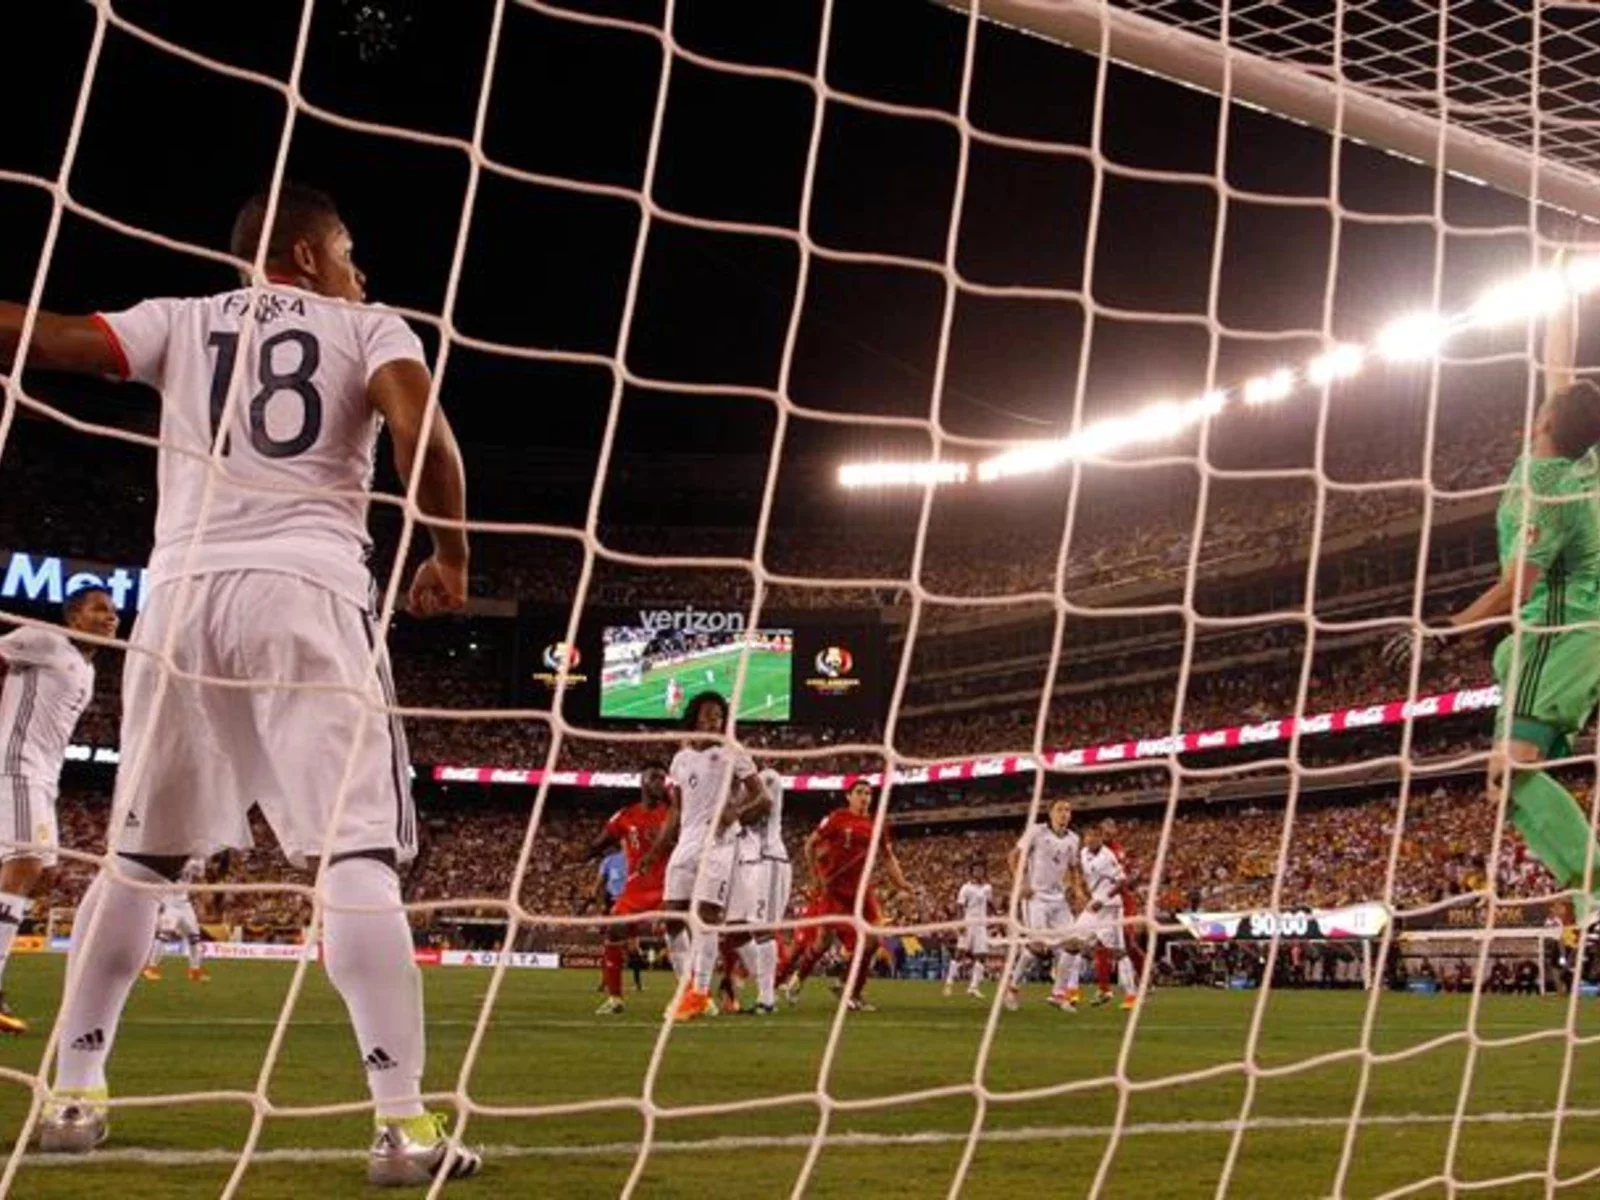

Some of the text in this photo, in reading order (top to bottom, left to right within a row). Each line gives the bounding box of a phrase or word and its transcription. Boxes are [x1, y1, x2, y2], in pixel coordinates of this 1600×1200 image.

[207, 328, 322, 458] 18
[638, 605, 744, 632] verizon
[1251, 910, 1308, 936] 9000
